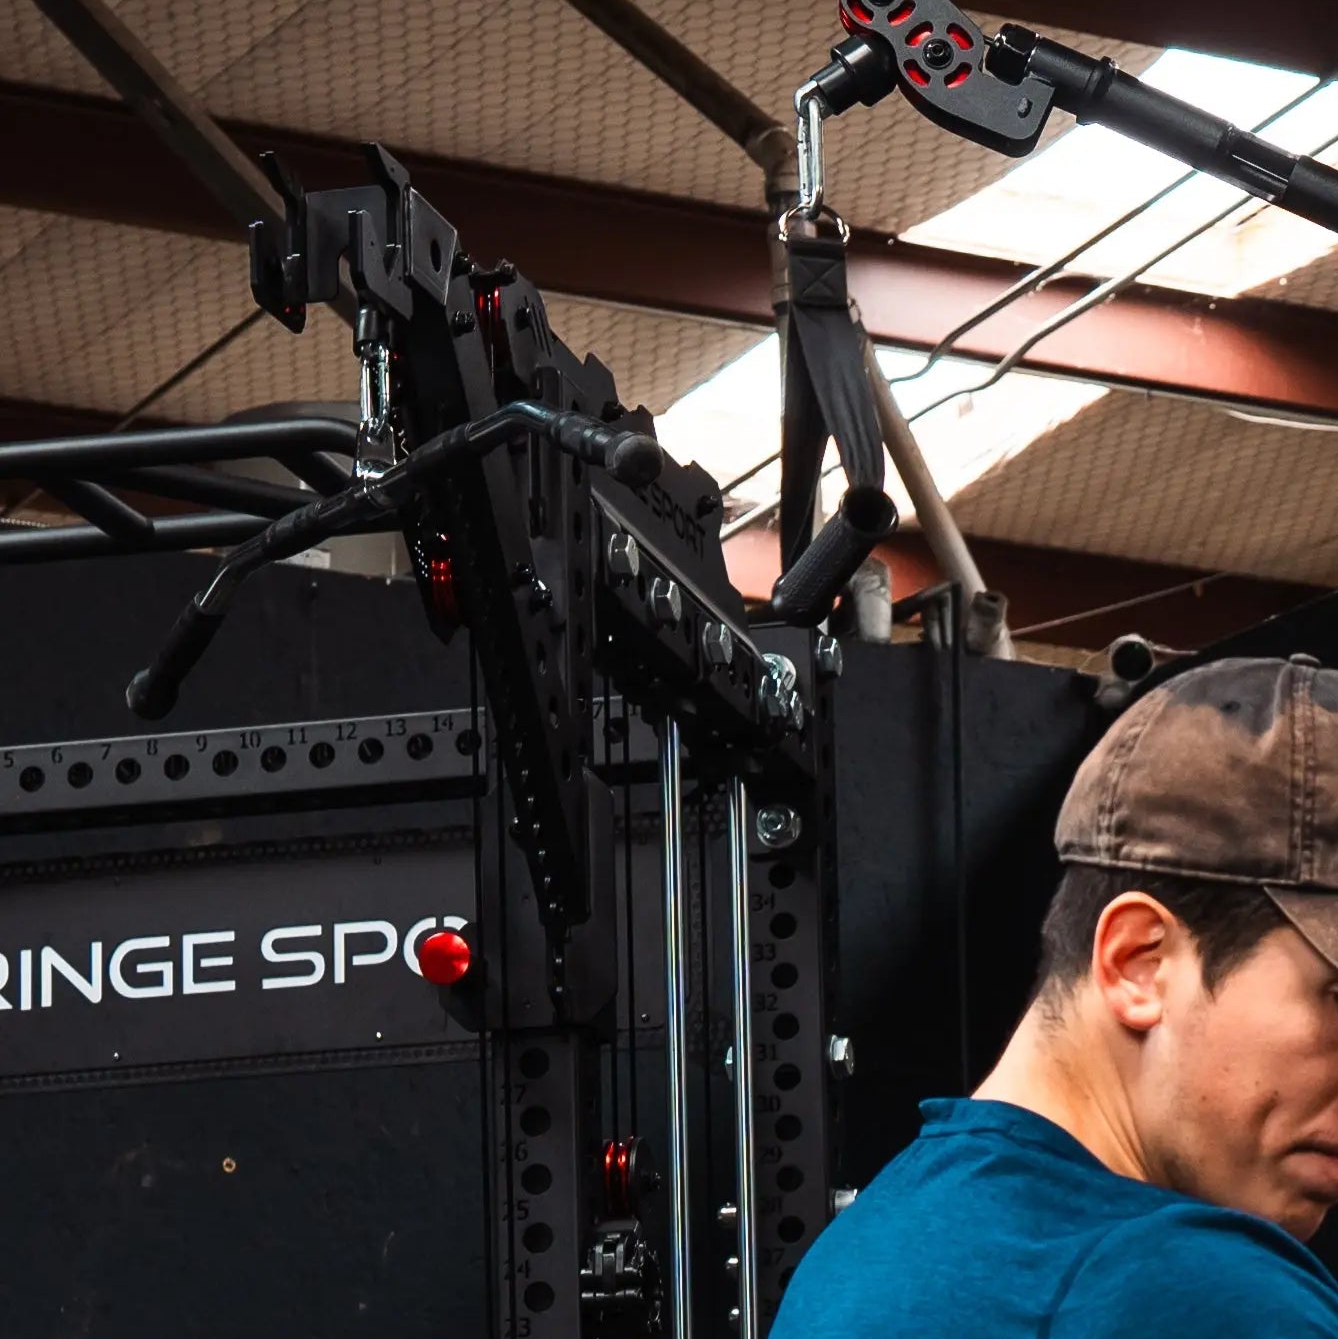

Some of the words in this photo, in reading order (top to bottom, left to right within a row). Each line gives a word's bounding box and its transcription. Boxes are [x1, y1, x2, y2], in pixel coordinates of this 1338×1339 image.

[649, 484, 706, 559] SPORT
[336, 723, 357, 741] 12
[386, 719, 407, 737] 13
[432, 715, 453, 733] 14
[196, 734, 207, 752] 9
[239, 731, 261, 749] 10
[287, 728, 308, 745] 11
[51, 746, 63, 764] 6
[101, 743, 112, 760] 7
[146, 738, 158, 756] 8
[4, 751, 15, 768] 5
